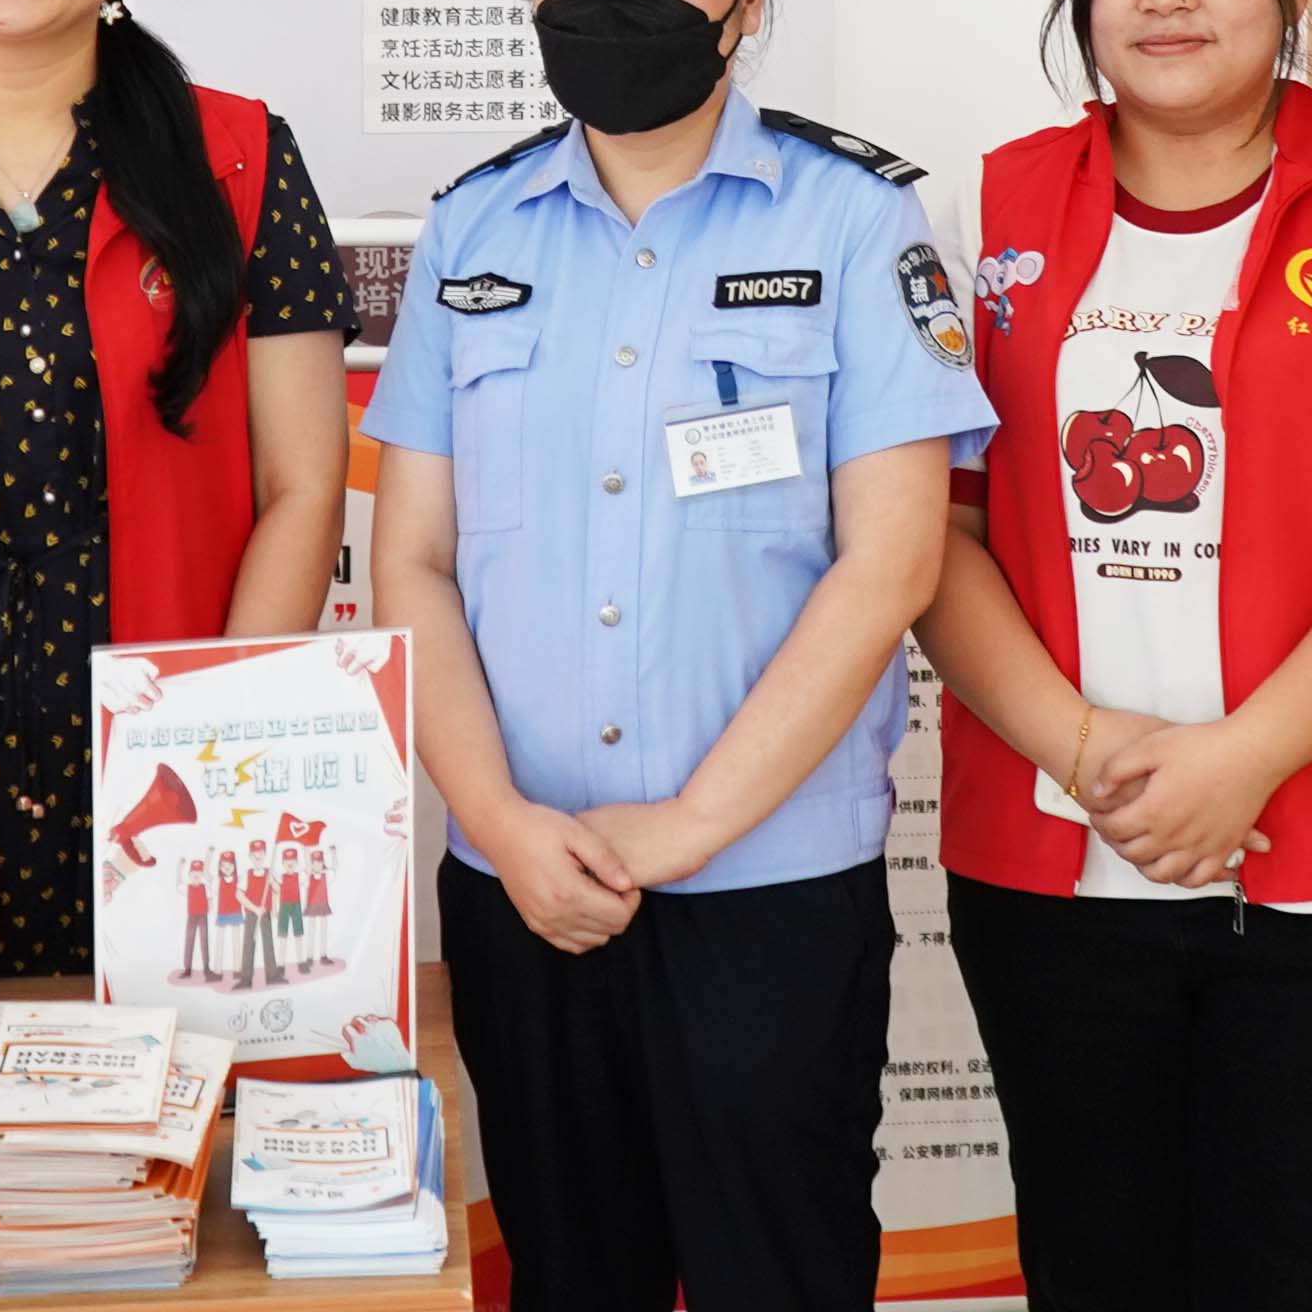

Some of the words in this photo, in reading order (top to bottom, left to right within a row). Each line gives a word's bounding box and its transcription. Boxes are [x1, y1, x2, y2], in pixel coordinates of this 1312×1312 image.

[725, 277, 814, 303] TN0057
[1063, 305, 1170, 342] RRY
[1112, 538, 1151, 557] VARY
[1164, 542, 1181, 558] IN
[1147, 567, 1176, 581] 1996
[893, 800, 939, 815] 供程序
